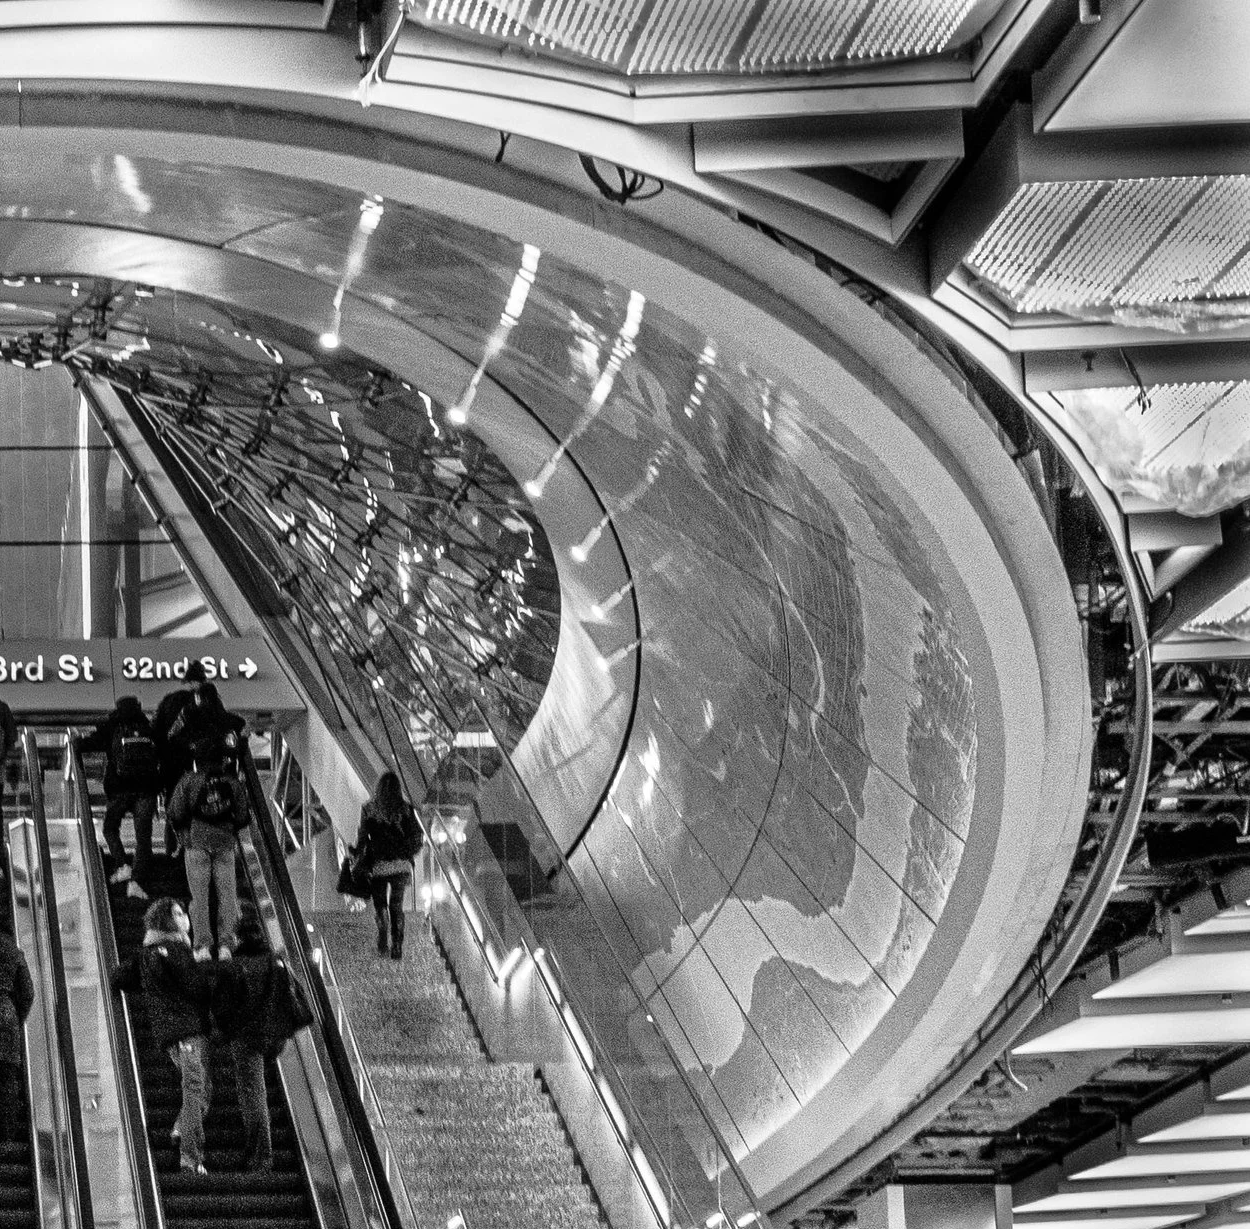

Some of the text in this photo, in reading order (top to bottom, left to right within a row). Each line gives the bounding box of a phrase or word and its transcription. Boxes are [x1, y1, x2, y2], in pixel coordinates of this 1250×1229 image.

[58, 654, 94, 682] St
[122, 656, 229, 679] 32nd St
